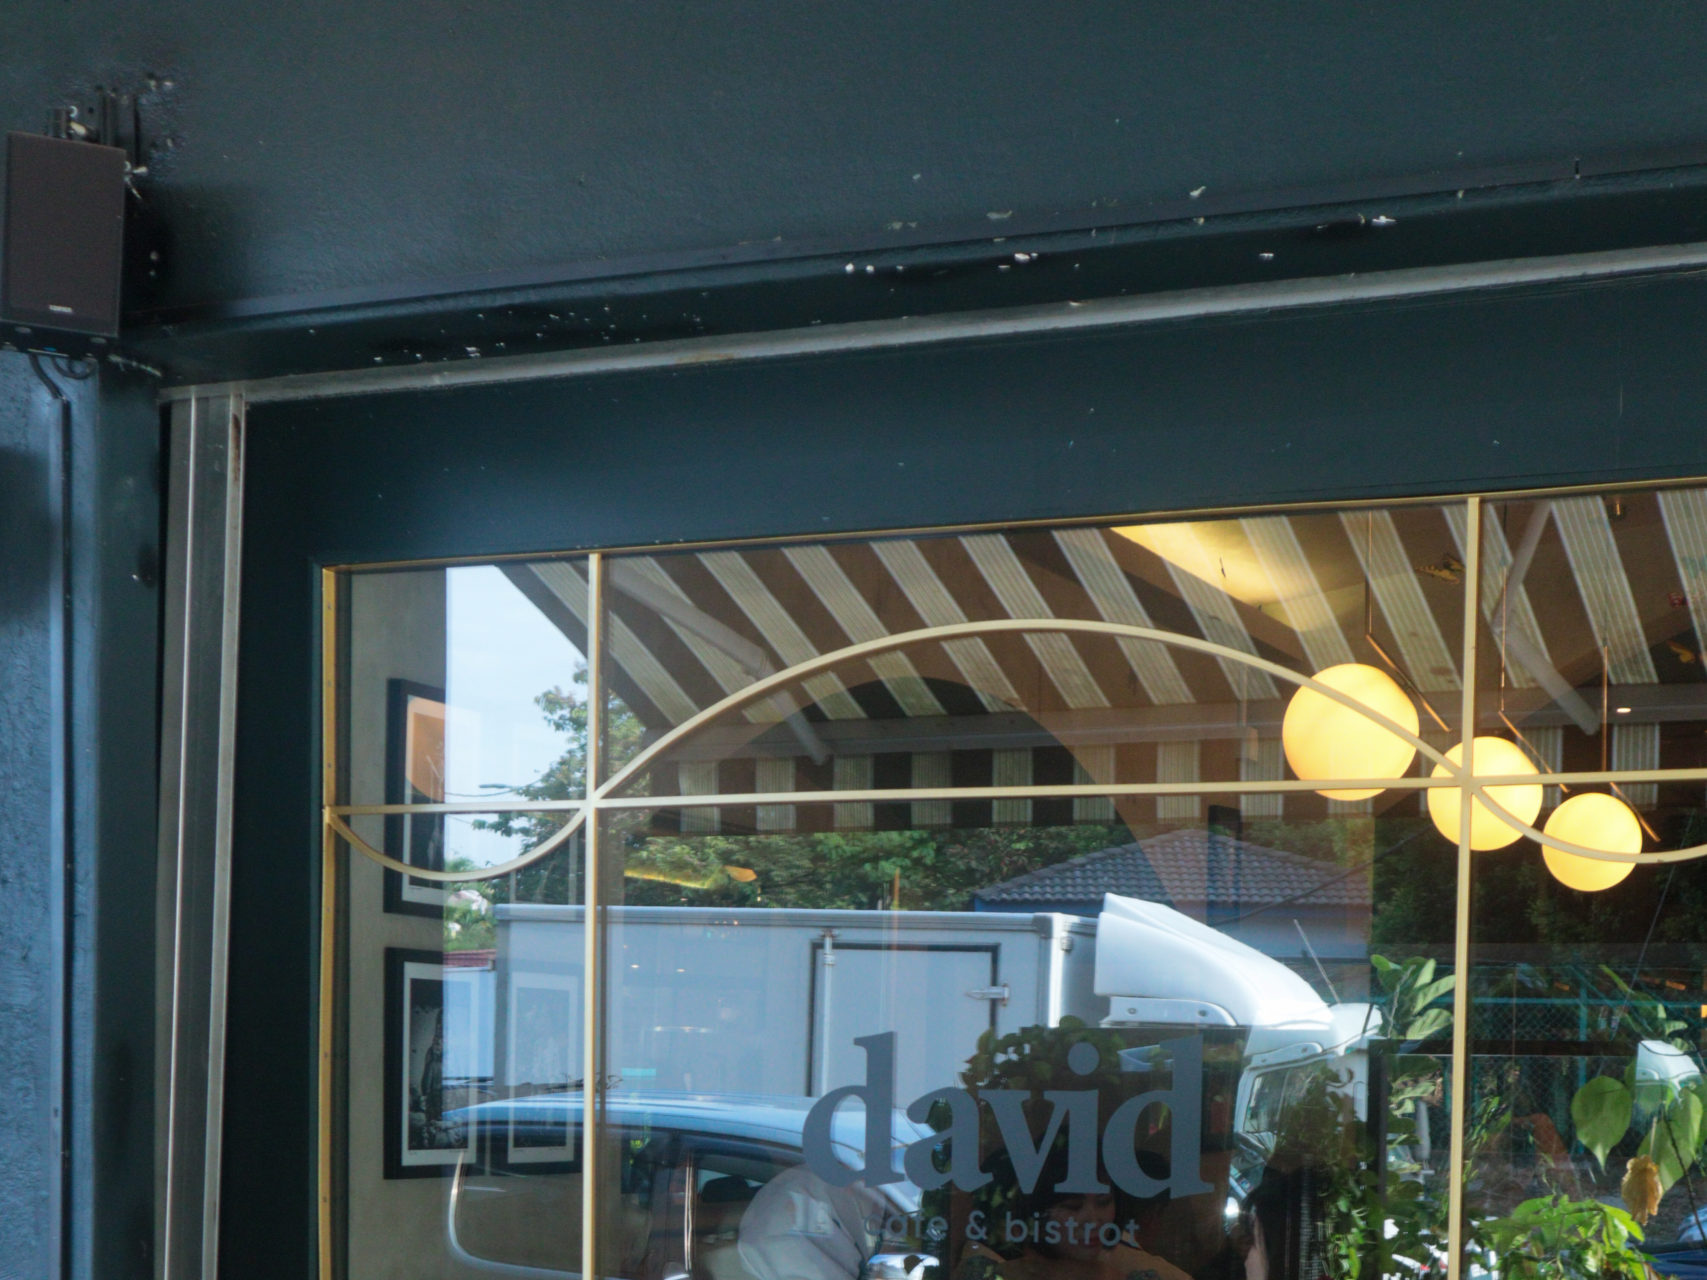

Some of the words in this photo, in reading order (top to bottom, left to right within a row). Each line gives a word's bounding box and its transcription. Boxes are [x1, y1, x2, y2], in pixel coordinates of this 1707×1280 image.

[802, 1031, 1215, 1199] david
[965, 1210, 987, 1240] &
[1005, 1211, 1140, 1249] bistrot
